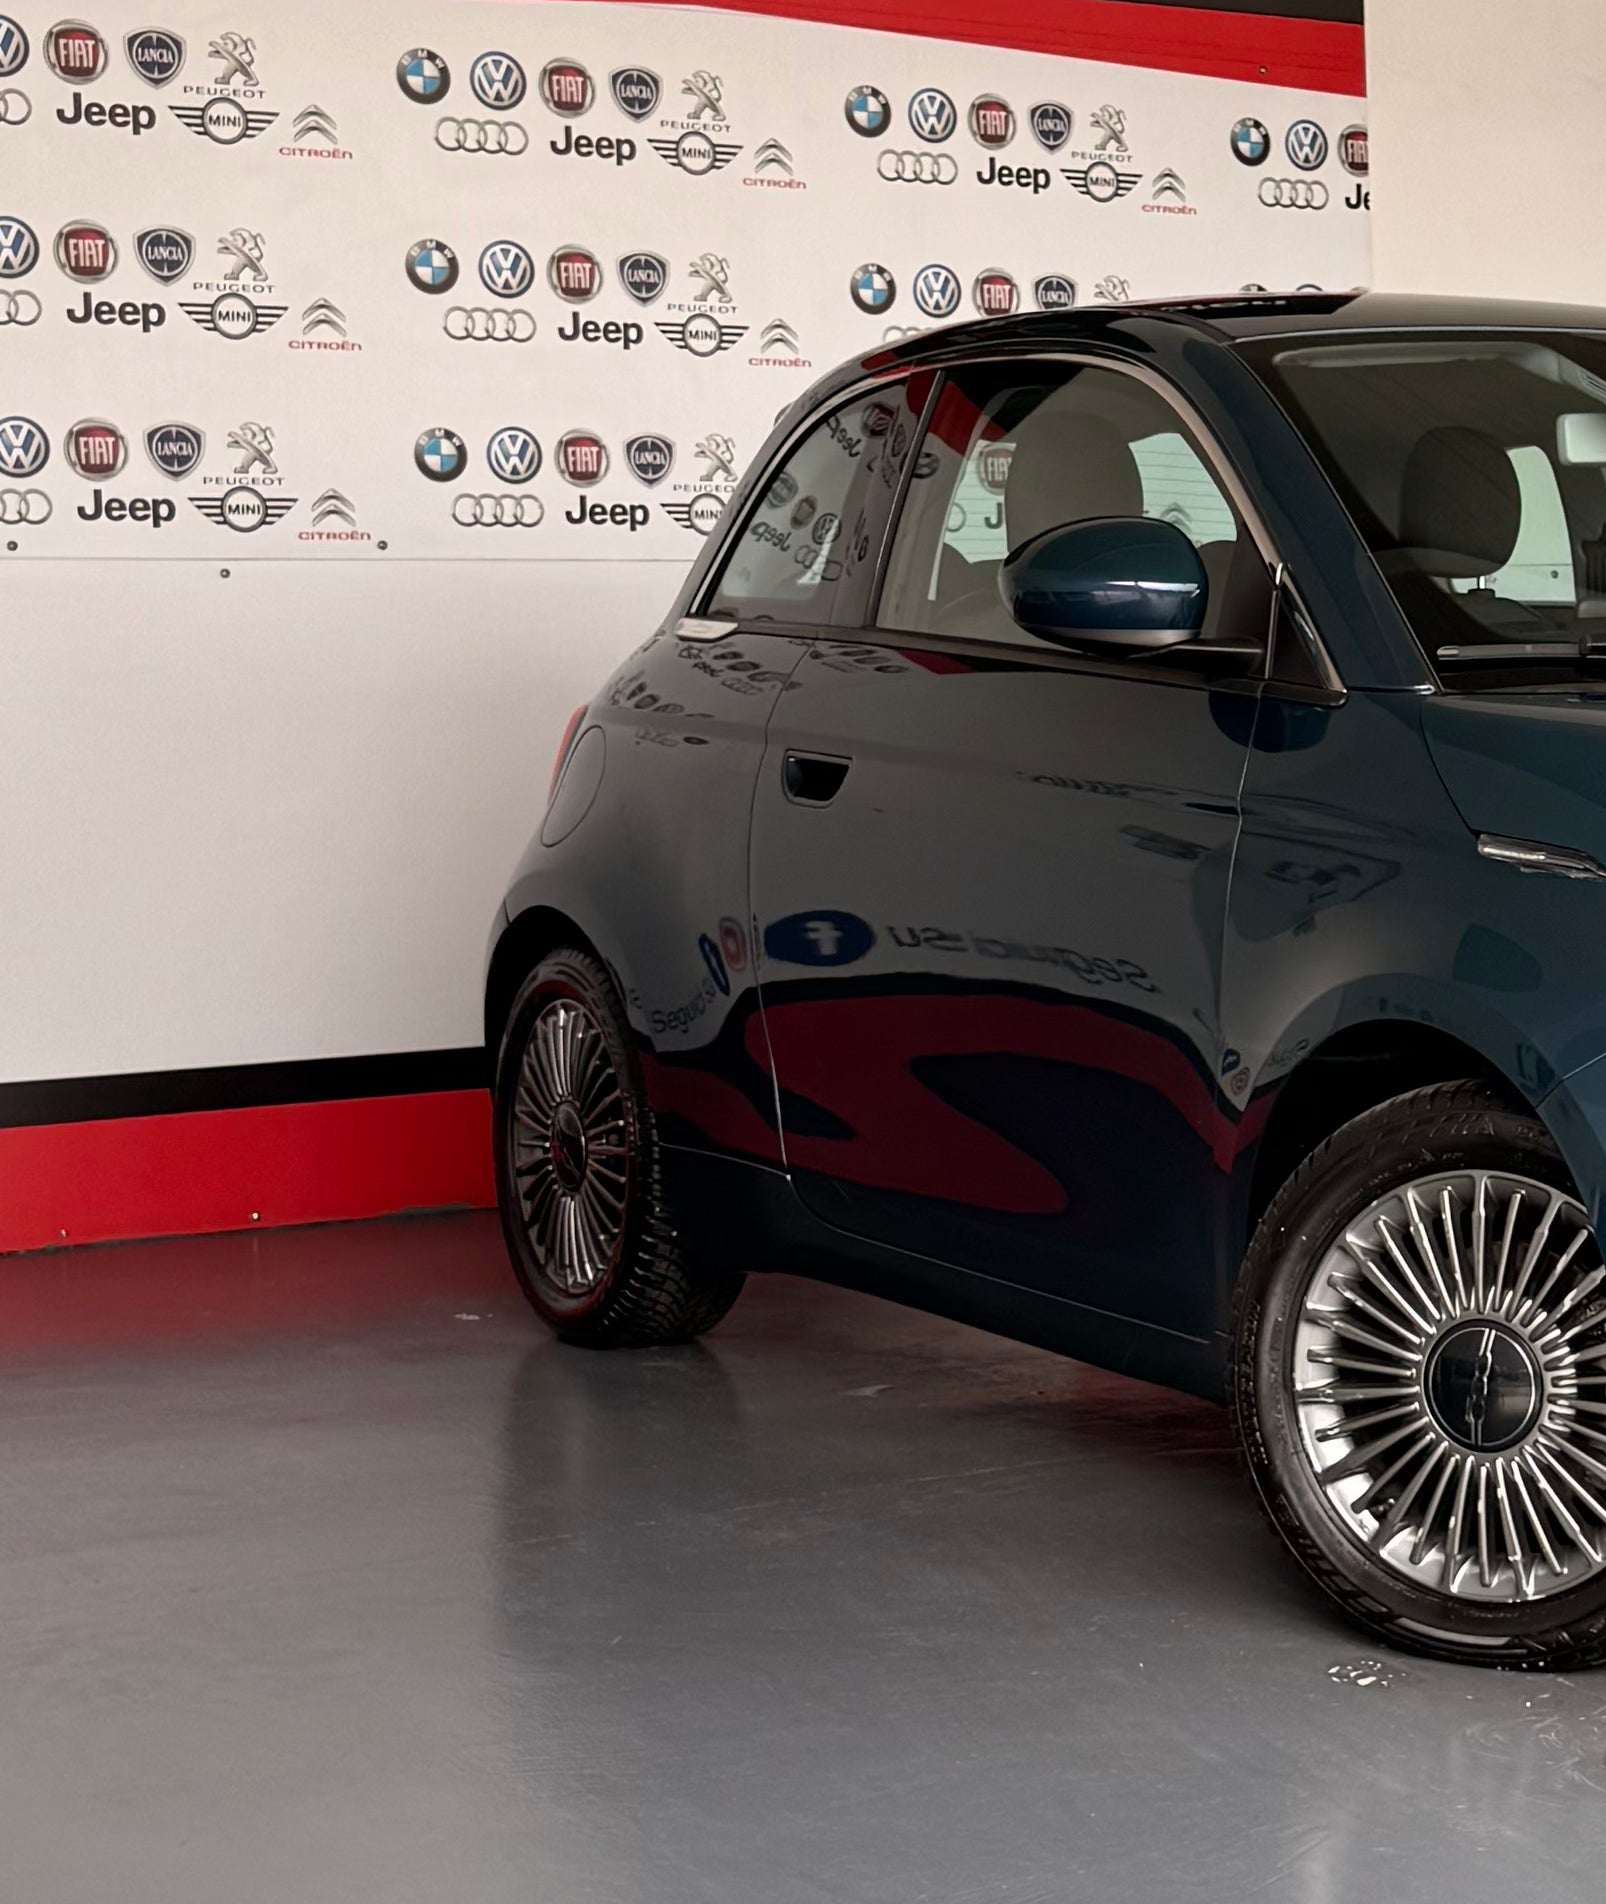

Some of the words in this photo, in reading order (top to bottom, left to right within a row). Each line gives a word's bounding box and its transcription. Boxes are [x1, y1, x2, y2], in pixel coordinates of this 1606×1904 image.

[58, 38, 96, 68] FIAT
[138, 47, 173, 65] LANCIA
[183, 86, 266, 99] PEUGEOT
[552, 74, 584, 104] FIAT
[620, 83, 652, 100] LANCIA
[56, 92, 156, 135] Jeep
[208, 114, 241, 129] MINI
[660, 119, 731, 133] PEUGEOT
[978, 110, 1007, 137] FIAT
[550, 126, 637, 166] Jeep
[681, 146, 712, 160] MINI
[1071, 151, 1133, 162] PEUGEOT
[977, 157, 1051, 194] Jeep
[1089, 176, 1116, 188] MINI
[68, 238, 106, 268] FIAT
[147, 244, 183, 262] LANCIA
[560, 262, 593, 289] FIAT
[193, 282, 276, 294] PEUGEOT
[983, 284, 1011, 309] FIAT
[66, 292, 166, 333] Jeep
[217, 308, 252, 324] MINI
[667, 303, 738, 315] PEUGEOT
[558, 311, 643, 350] Jeep
[689, 329, 717, 342] MINI
[79, 436, 115, 465] FIAT
[157, 441, 193, 457] LANCIA
[567, 445, 599, 470] FIAT
[203, 476, 285, 486] PEUGEOT
[673, 484, 736, 493] PEUGEO
[77, 489, 176, 528] Jeep
[227, 503, 261, 517] MINI
[565, 495, 650, 531] Jeep
